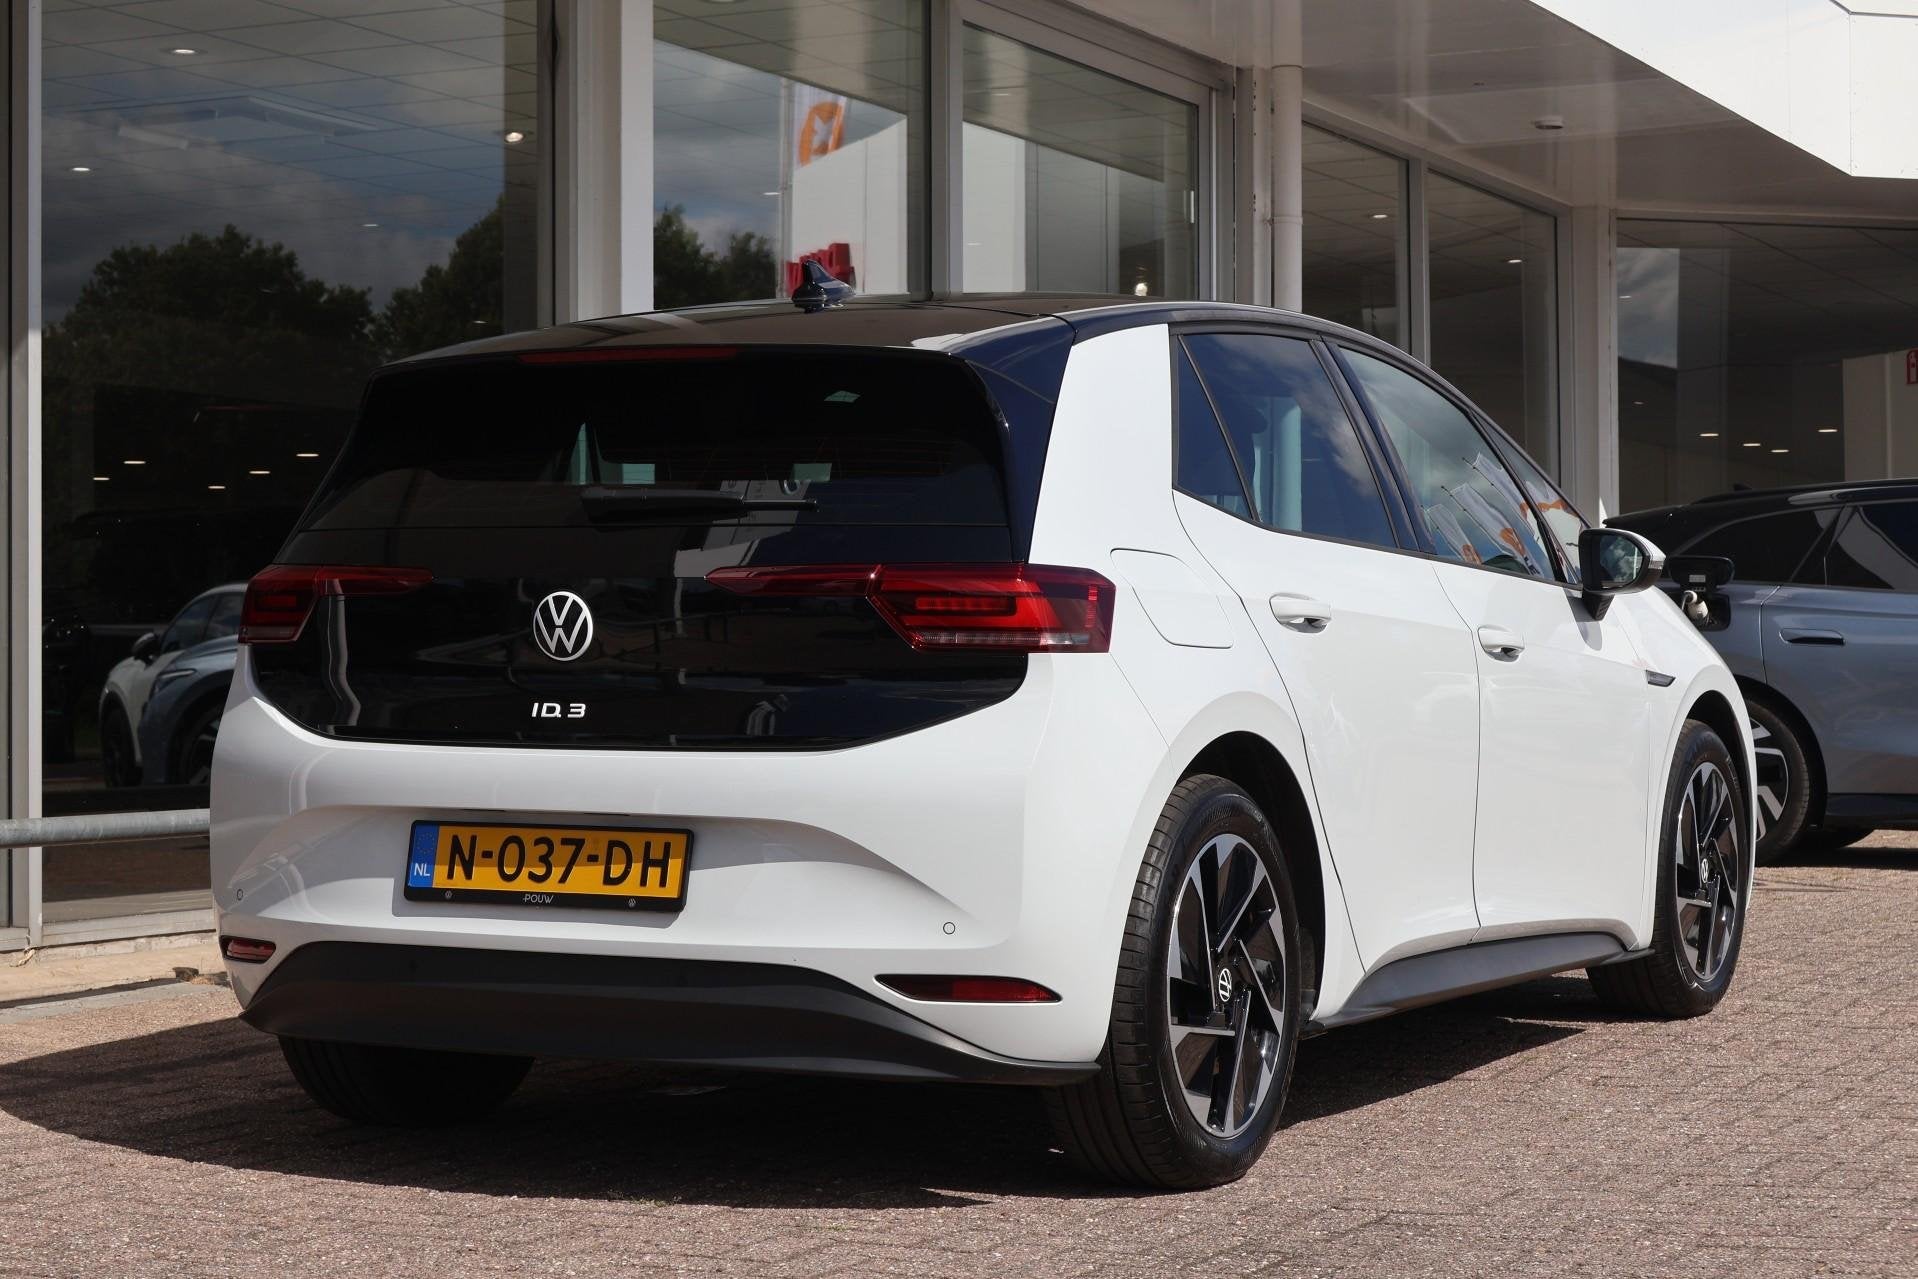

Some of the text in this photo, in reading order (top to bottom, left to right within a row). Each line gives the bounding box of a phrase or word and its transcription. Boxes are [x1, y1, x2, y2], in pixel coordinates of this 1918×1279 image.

[446, 834, 672, 888] N-037-DH
[413, 863, 431, 877] NL
[523, 893, 554, 904] POUW
